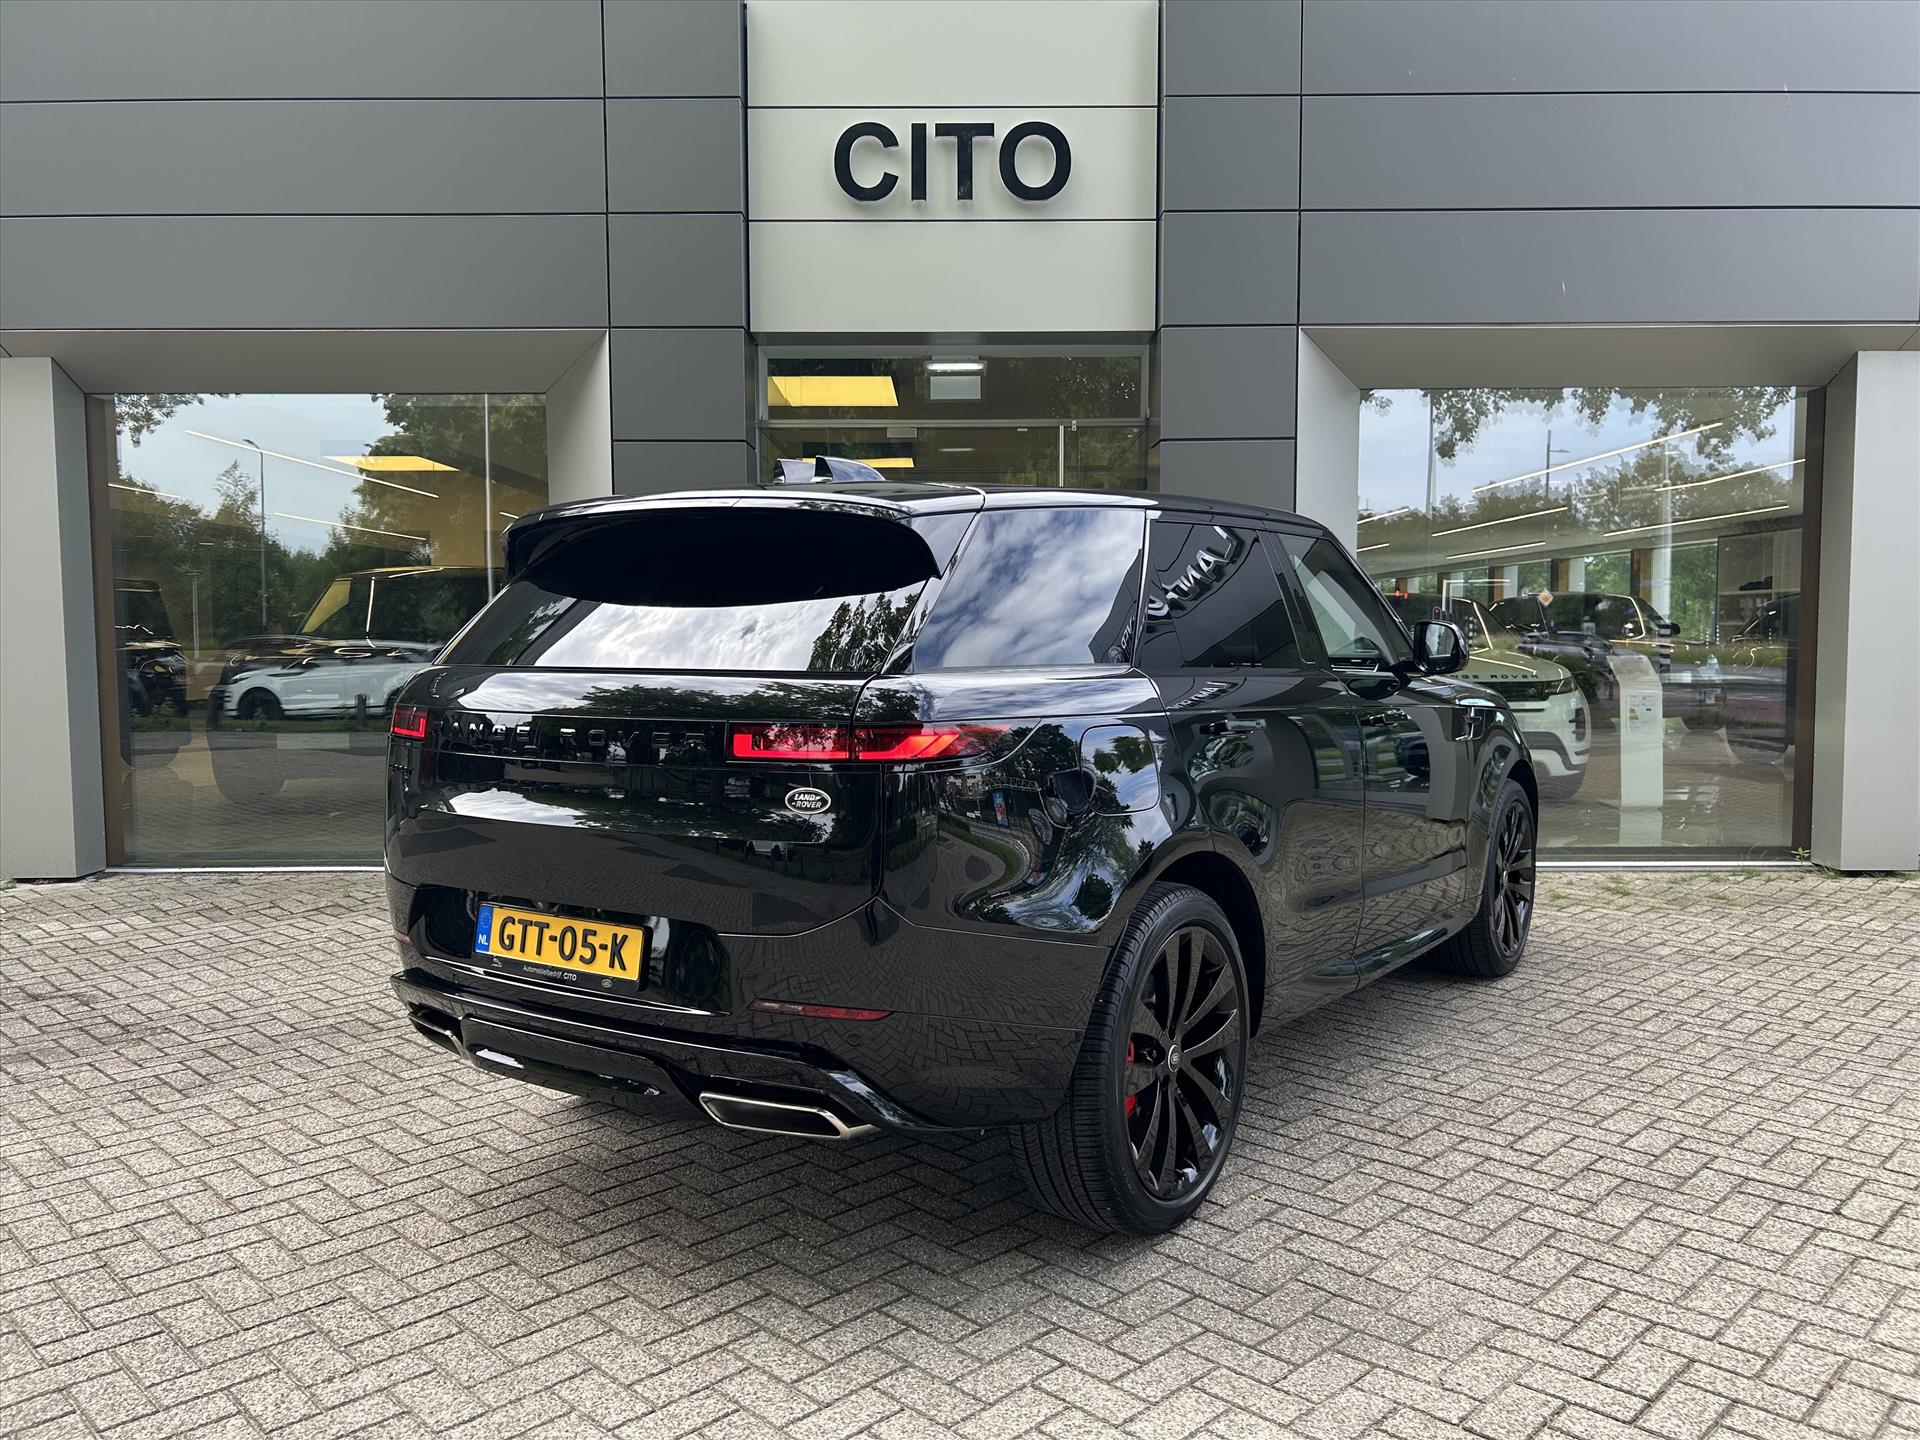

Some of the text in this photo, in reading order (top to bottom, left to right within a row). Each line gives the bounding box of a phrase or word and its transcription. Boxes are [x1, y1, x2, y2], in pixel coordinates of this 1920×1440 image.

[834, 121, 1072, 202] CITO
[432, 719, 706, 752] RANGE ROVER
[794, 793, 816, 801] LAND
[478, 935, 488, 946] NL
[499, 916, 628, 971] GTT-05-K
[563, 972, 577, 981] CITO
